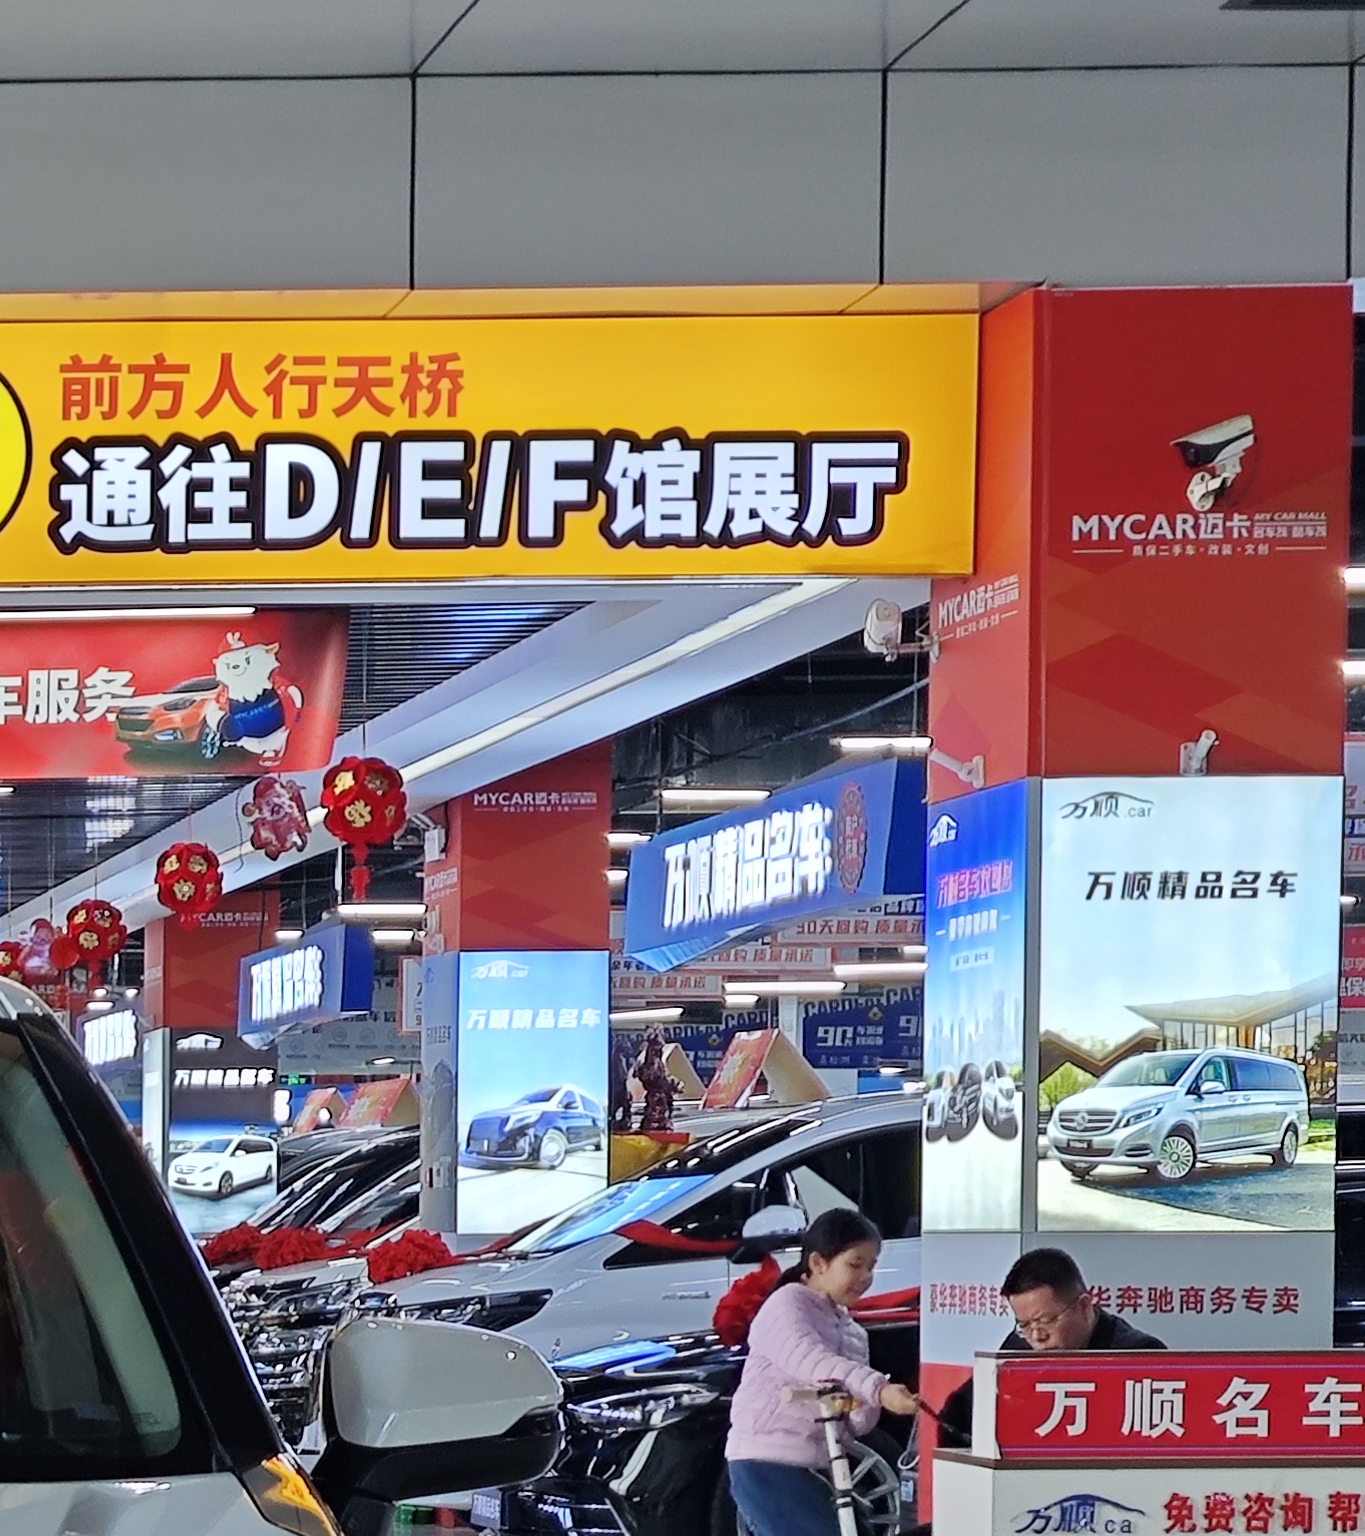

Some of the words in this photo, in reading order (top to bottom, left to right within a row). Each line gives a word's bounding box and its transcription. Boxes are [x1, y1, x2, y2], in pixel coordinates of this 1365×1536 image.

[57, 351, 465, 422] 前方人行天桥
[60, 434, 904, 548] 通往D/E/F馆展厅
[1084, 869, 1299, 902] 万顺精品名车
[1034, 1376, 1364, 1439] 万顺名车
[1163, 1492, 1314, 1534] 免费咨询
[1327, 1490, 1362, 1533] 帮
